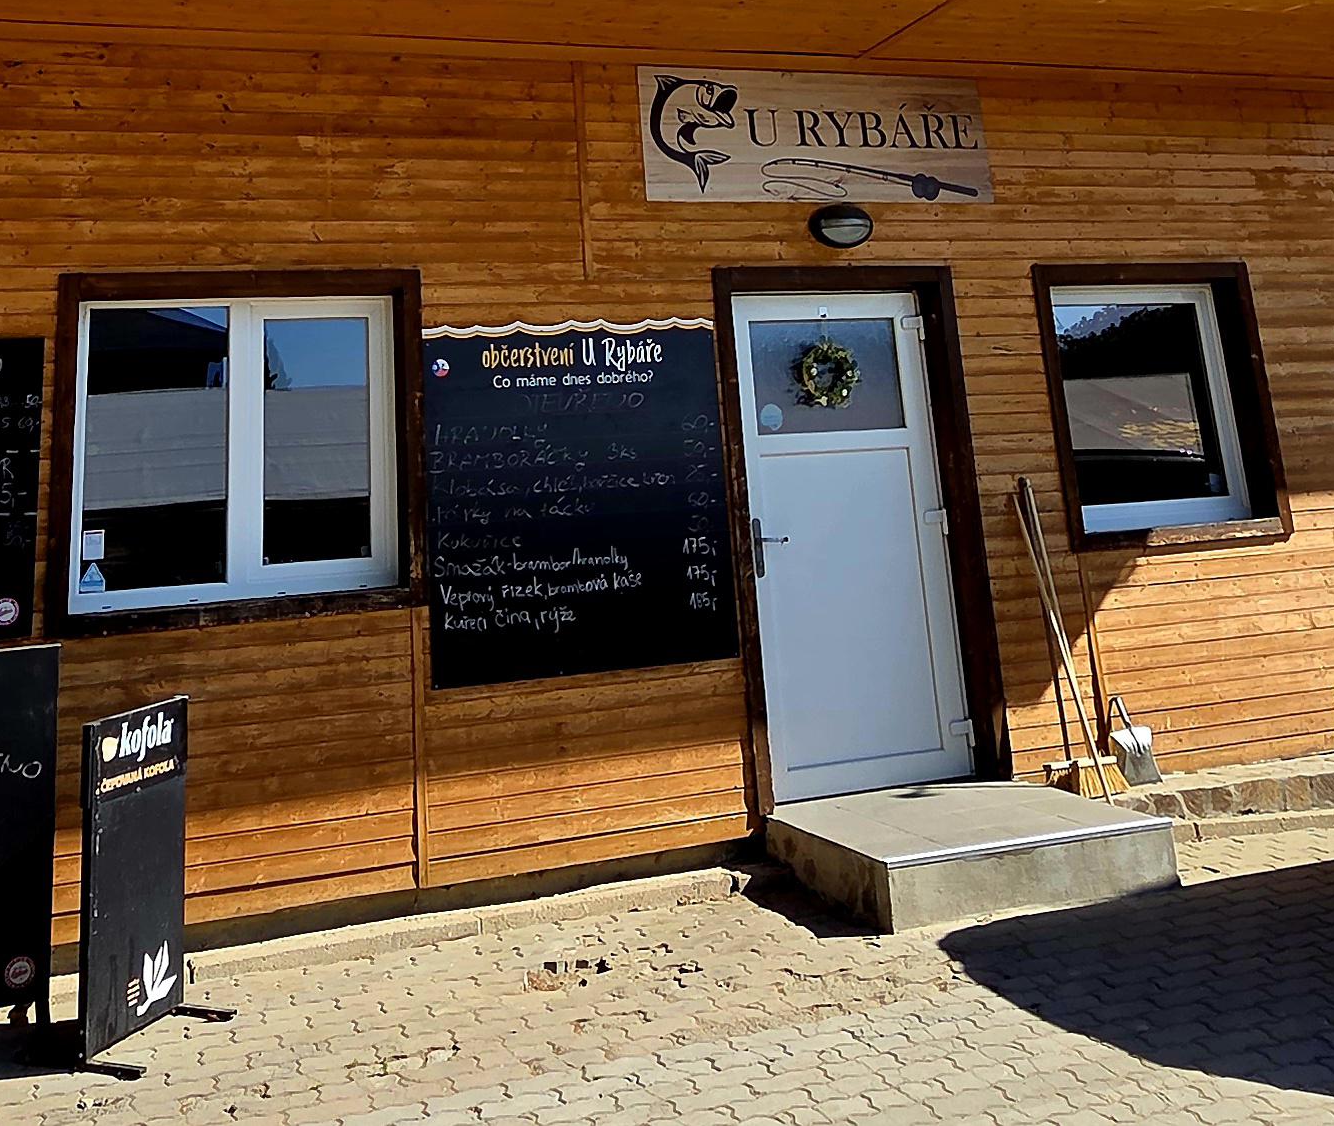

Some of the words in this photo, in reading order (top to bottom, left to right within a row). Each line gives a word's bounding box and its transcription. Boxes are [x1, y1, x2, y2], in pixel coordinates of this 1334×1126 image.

[742, 108, 779, 147] U
[793, 102, 979, 150] RYBÁŘE
[482, 341, 575, 369] občerstvení
[582, 337, 597, 366] U
[601, 338, 663, 371] Rybáře
[493, 375, 511, 388] Co
[516, 373, 557, 388] máme
[562, 372, 592, 386] dnes
[596, 369, 655, 384] dobrého?
[118, 711, 172, 762] kofola
[100, 765, 143, 793] ČEPOVANÁ
[143, 758, 175, 780] KOFOLA
